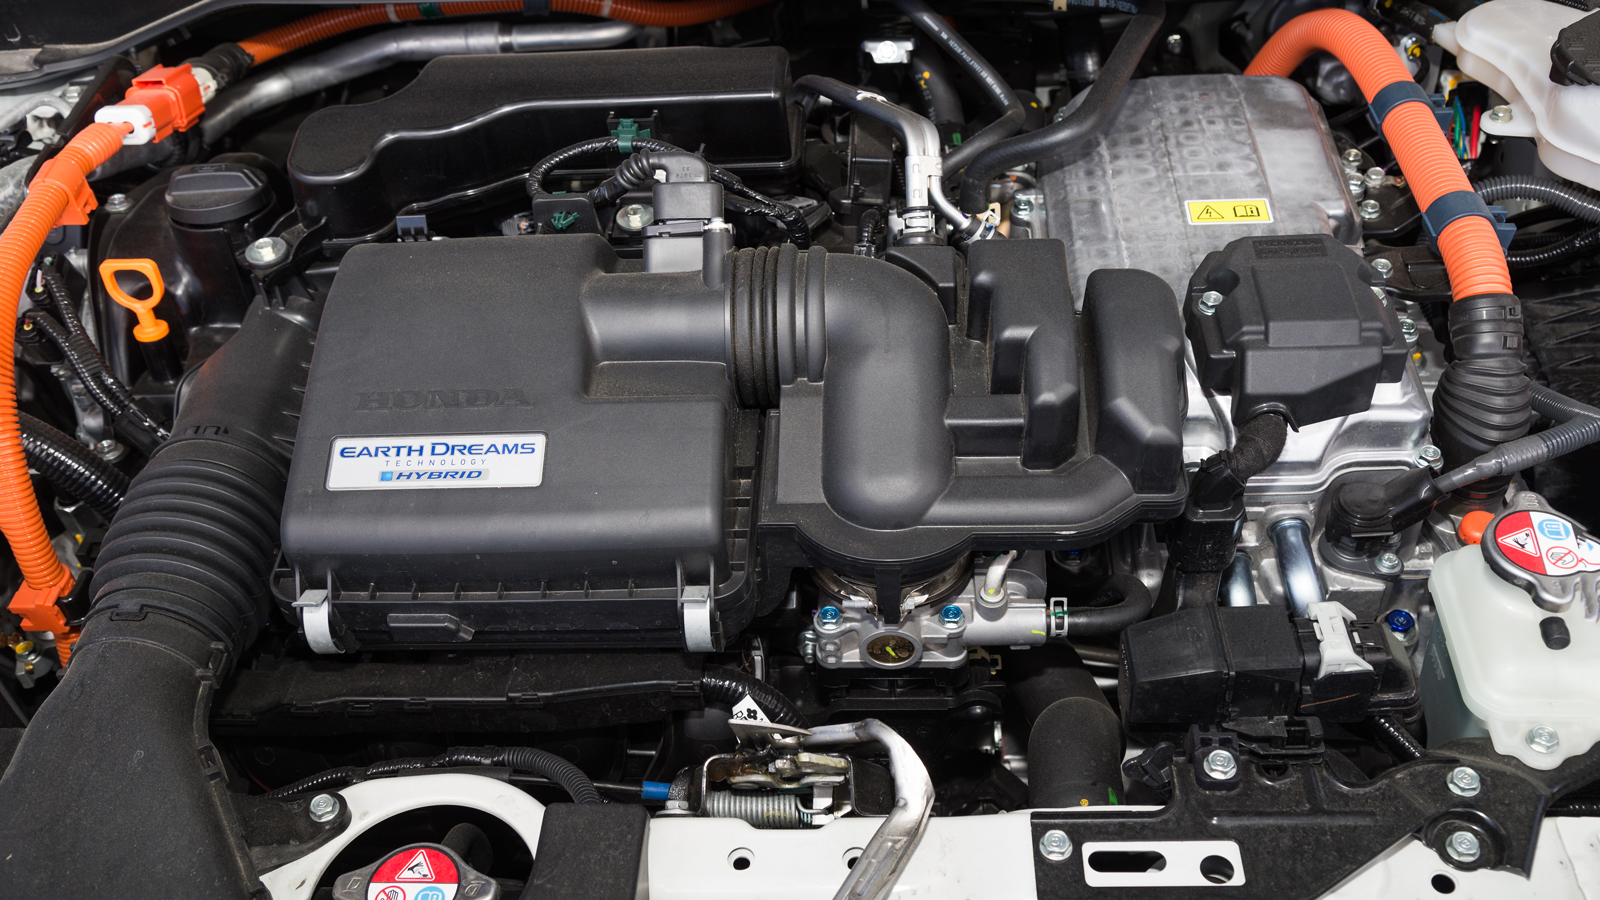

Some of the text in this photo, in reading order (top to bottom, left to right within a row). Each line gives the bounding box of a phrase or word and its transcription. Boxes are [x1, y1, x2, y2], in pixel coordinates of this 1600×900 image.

[354, 388, 536, 411] HONDA
[340, 442, 536, 458] EARTH DREAMS
[385, 458, 487, 467] TECHNOLOGY
[396, 470, 482, 480] HYBRID
